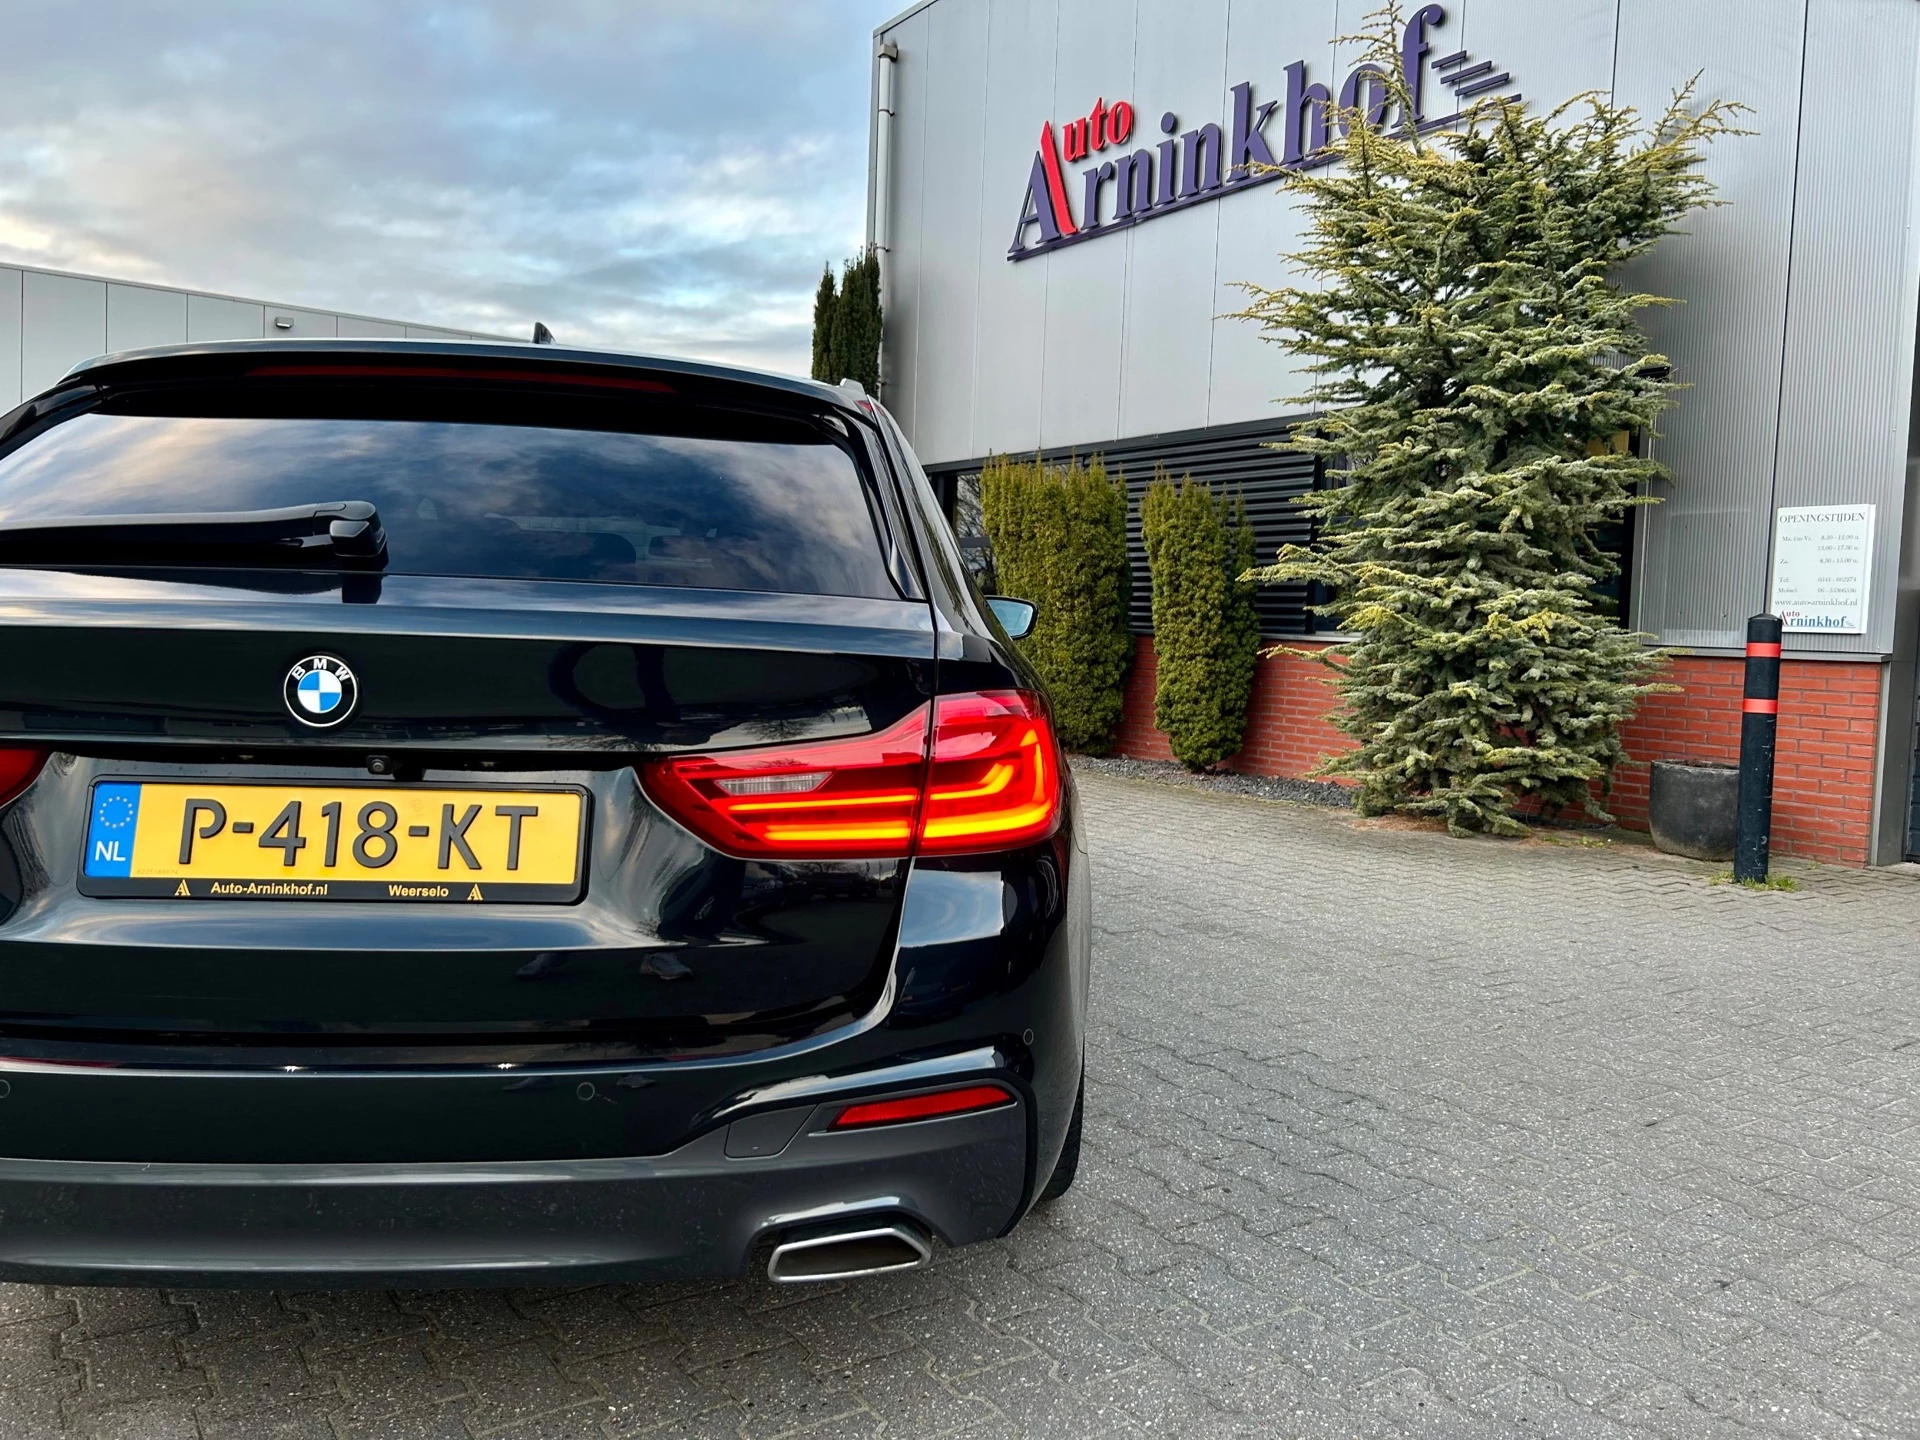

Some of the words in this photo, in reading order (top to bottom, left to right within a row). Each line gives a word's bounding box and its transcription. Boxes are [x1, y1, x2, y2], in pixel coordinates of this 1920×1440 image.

[1007, 3, 1444, 254] Arninkhof
[1779, 512, 1866, 524] OPENINGSTIJDEN
[291, 658, 351, 682] BMW
[178, 798, 539, 871] P-418-KT
[94, 840, 127, 862] NL
[210, 881, 329, 896] Auto-Arninkhof.nl
[388, 884, 450, 898] Weerselo
